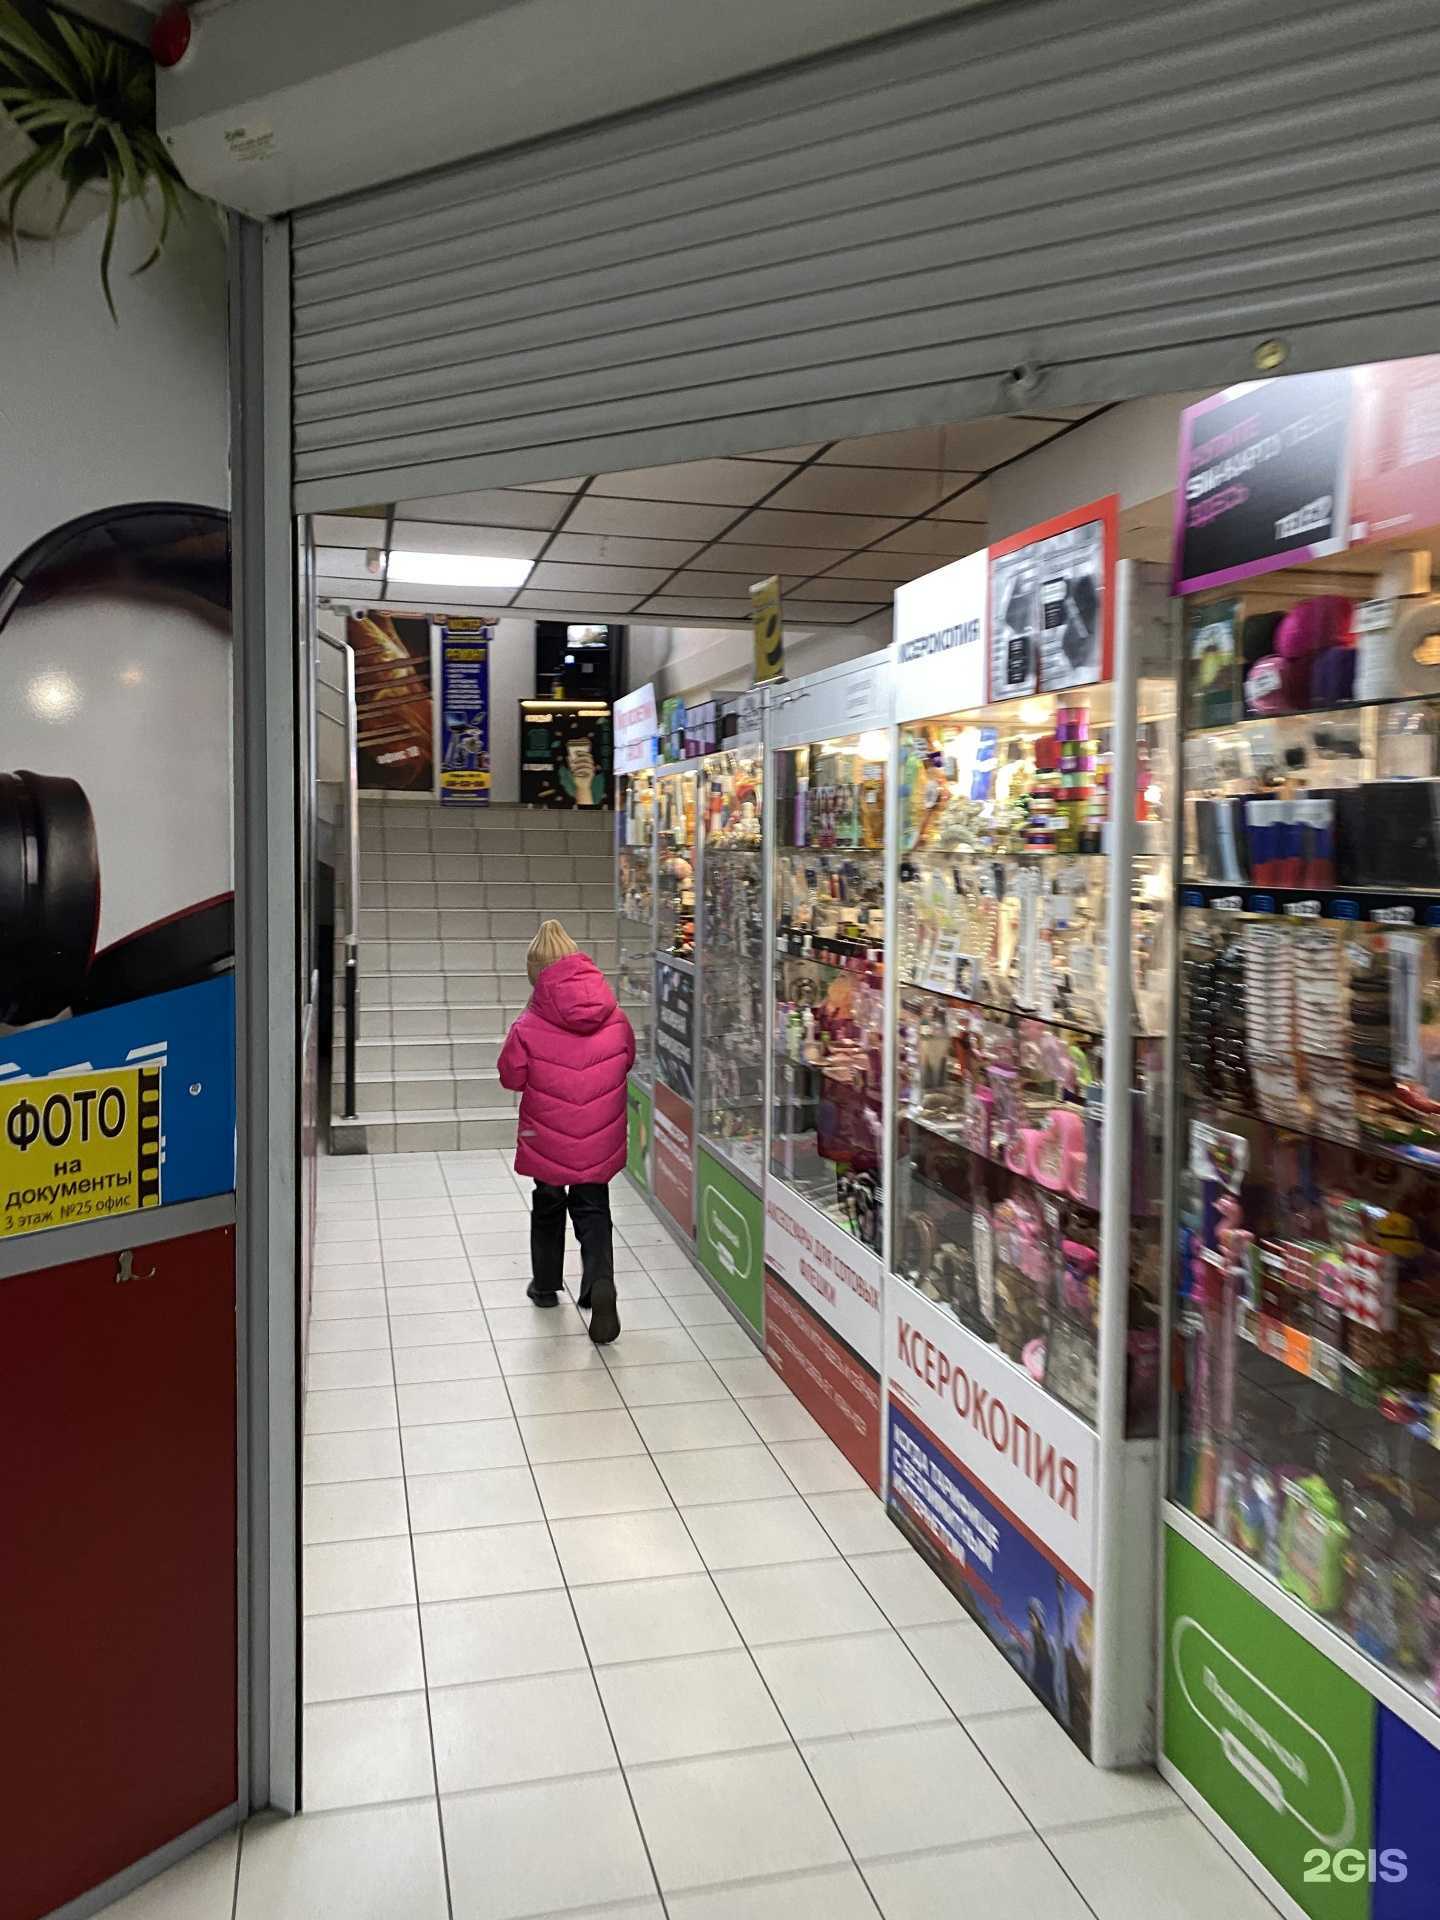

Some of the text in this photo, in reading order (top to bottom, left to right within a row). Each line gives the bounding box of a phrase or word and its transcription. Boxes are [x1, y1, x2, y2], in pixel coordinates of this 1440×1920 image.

[7, 1087, 126, 1151] ФОТО
[54, 1159, 82, 1177] на
[5, 1171, 132, 1210] документы
[6, 1195, 131, 1230] 3 этаж №25 офис
[897, 1316, 1079, 1521] КСЕРОКОПИЯ
